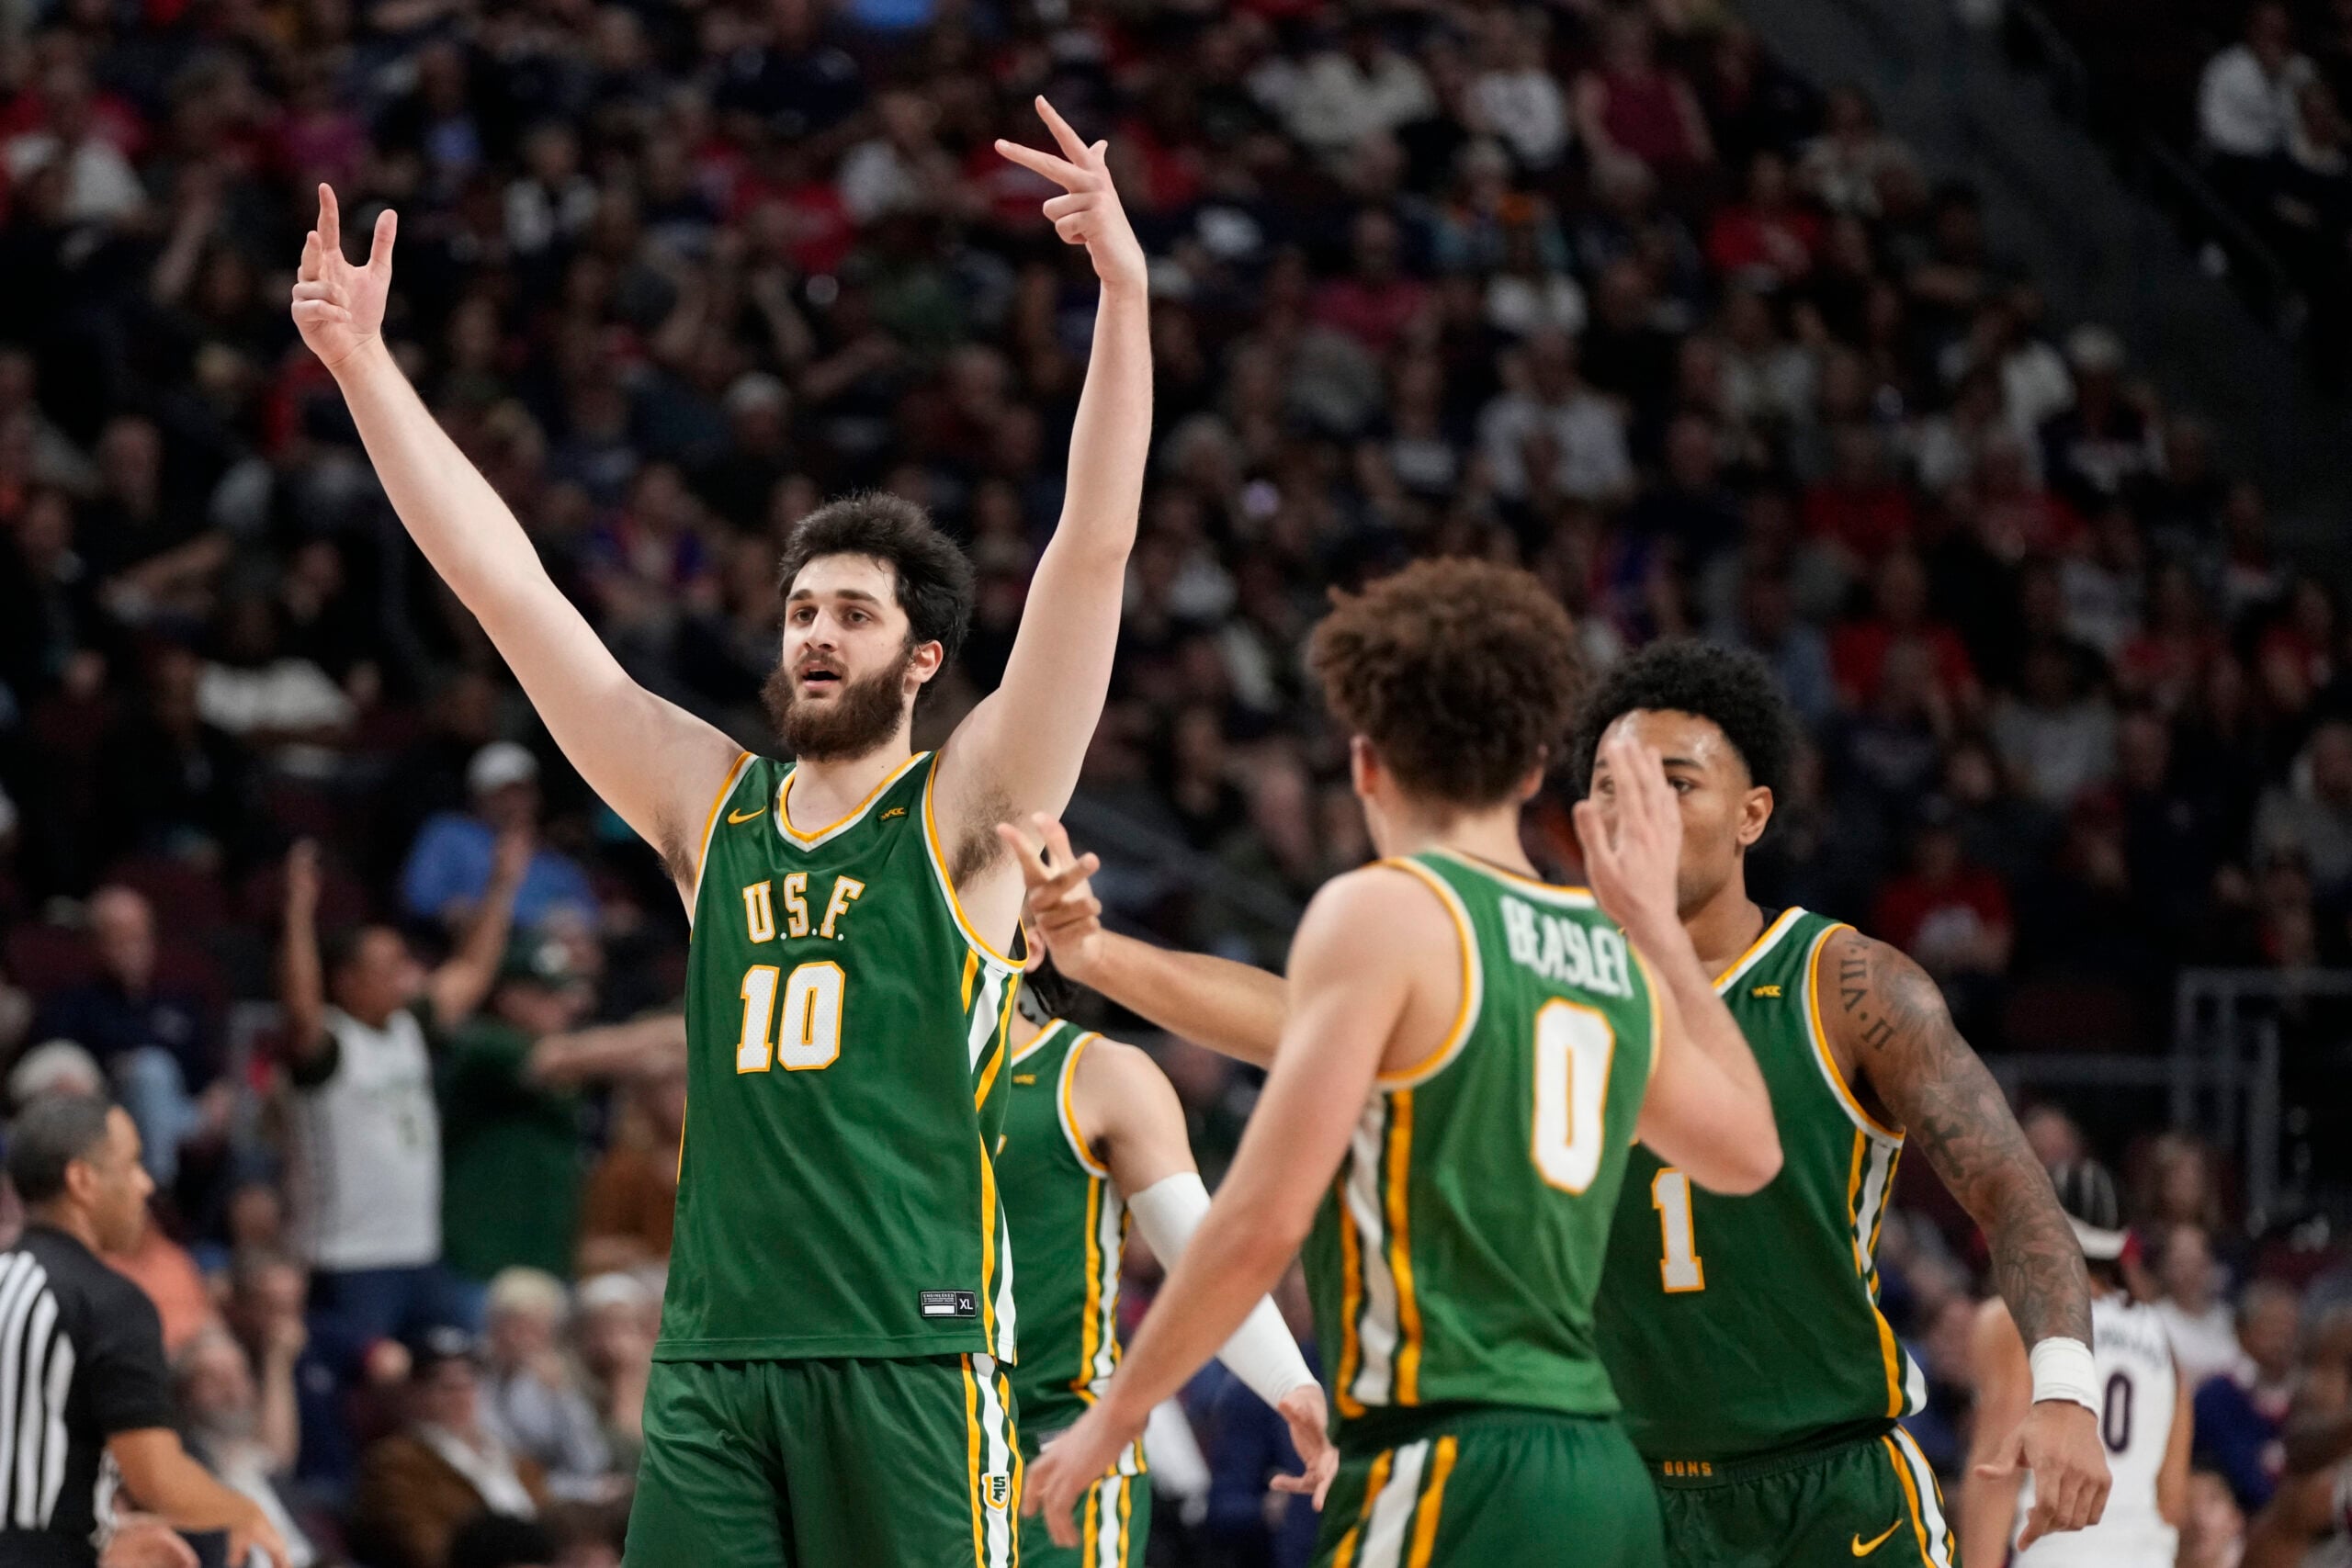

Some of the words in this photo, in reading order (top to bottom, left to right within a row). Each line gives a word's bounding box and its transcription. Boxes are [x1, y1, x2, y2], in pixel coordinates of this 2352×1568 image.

[742, 872, 865, 944] U.S.F.
[736, 960, 846, 1075] 10
[1530, 996, 1616, 1196] 0
[1651, 1167, 1706, 1293] 1
[959, 1298, 974, 1310] XL
[2103, 1372, 2132, 1453] 0
[1664, 1461, 1713, 1477] DONS
